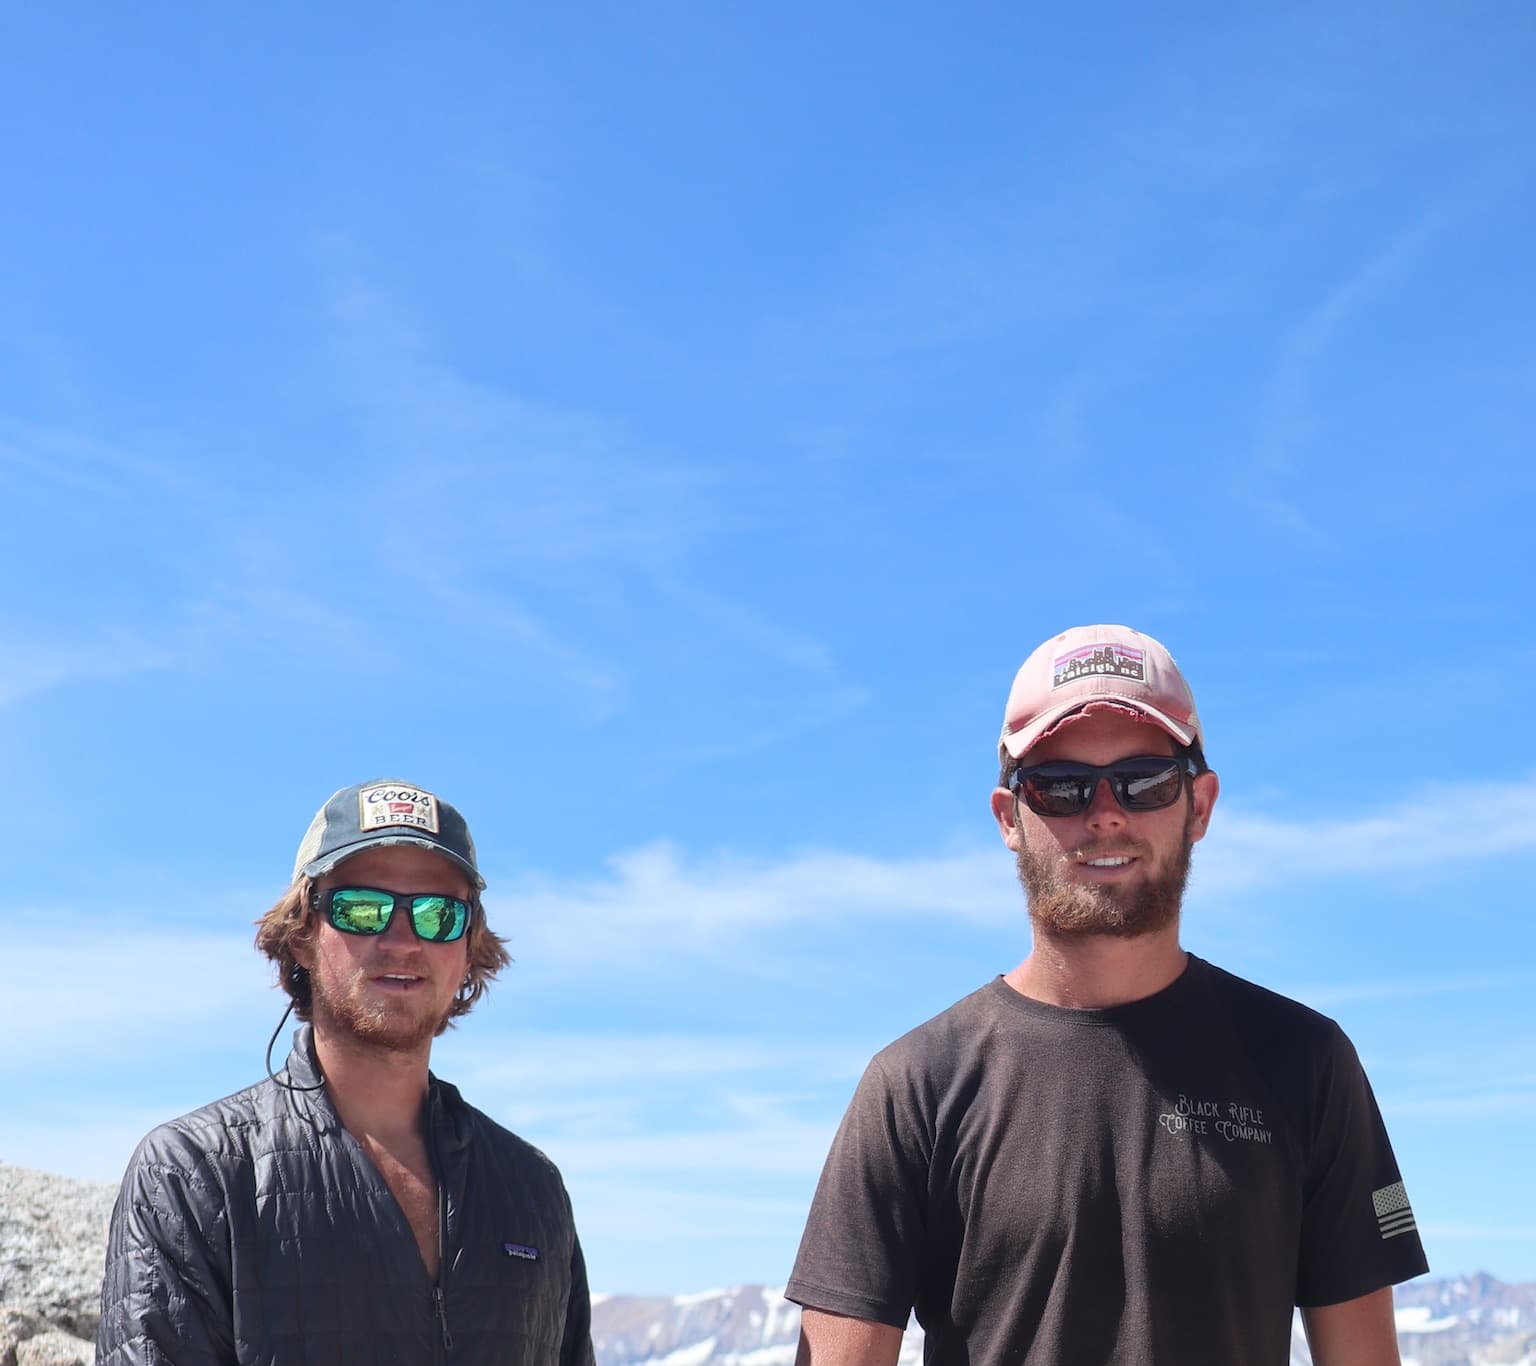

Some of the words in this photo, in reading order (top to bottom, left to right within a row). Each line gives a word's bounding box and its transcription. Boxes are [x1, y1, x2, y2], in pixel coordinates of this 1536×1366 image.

[1059, 663, 1115, 682] raleigh
[1120, 666, 1139, 677] nc
[367, 789, 430, 807] Coors
[374, 814, 427, 826] BEER
